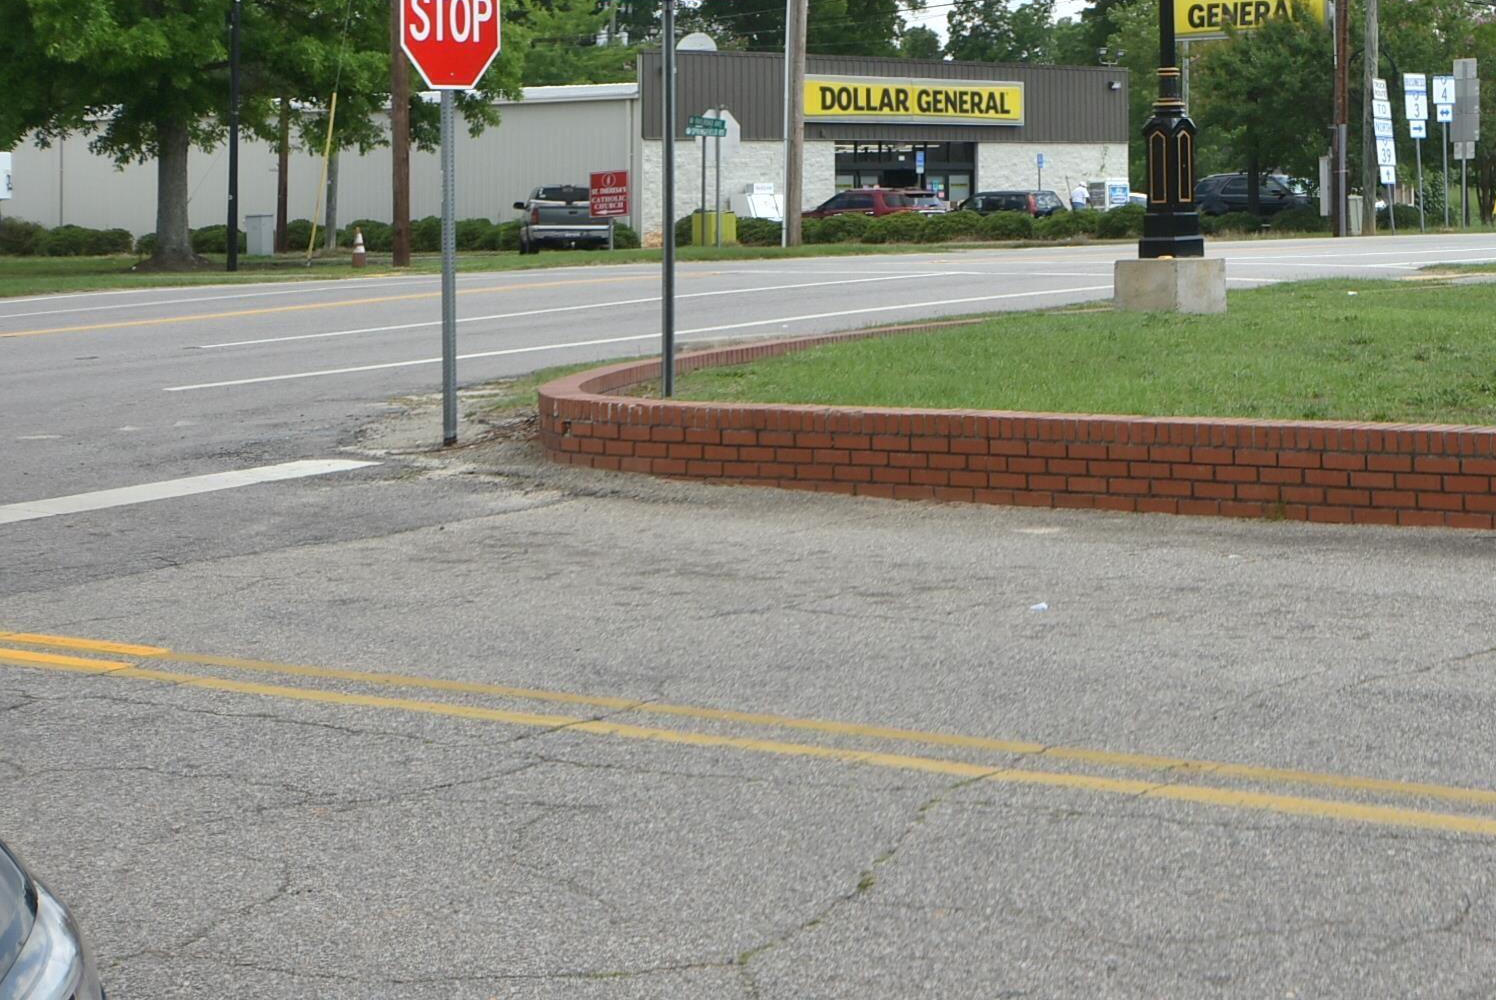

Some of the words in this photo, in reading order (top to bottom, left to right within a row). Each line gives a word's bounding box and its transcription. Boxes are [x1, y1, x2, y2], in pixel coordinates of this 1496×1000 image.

[819, 85, 910, 112] DOLLAR
[917, 89, 1011, 115] GENERAL
[1441, 87, 1448, 101] 4
[1377, 103, 1387, 114] TO
[1414, 103, 1420, 118] 3
[1381, 148, 1391, 163] 39
[591, 195, 626, 203] CATHOLIC
[594, 202, 624, 210] CHURCH
